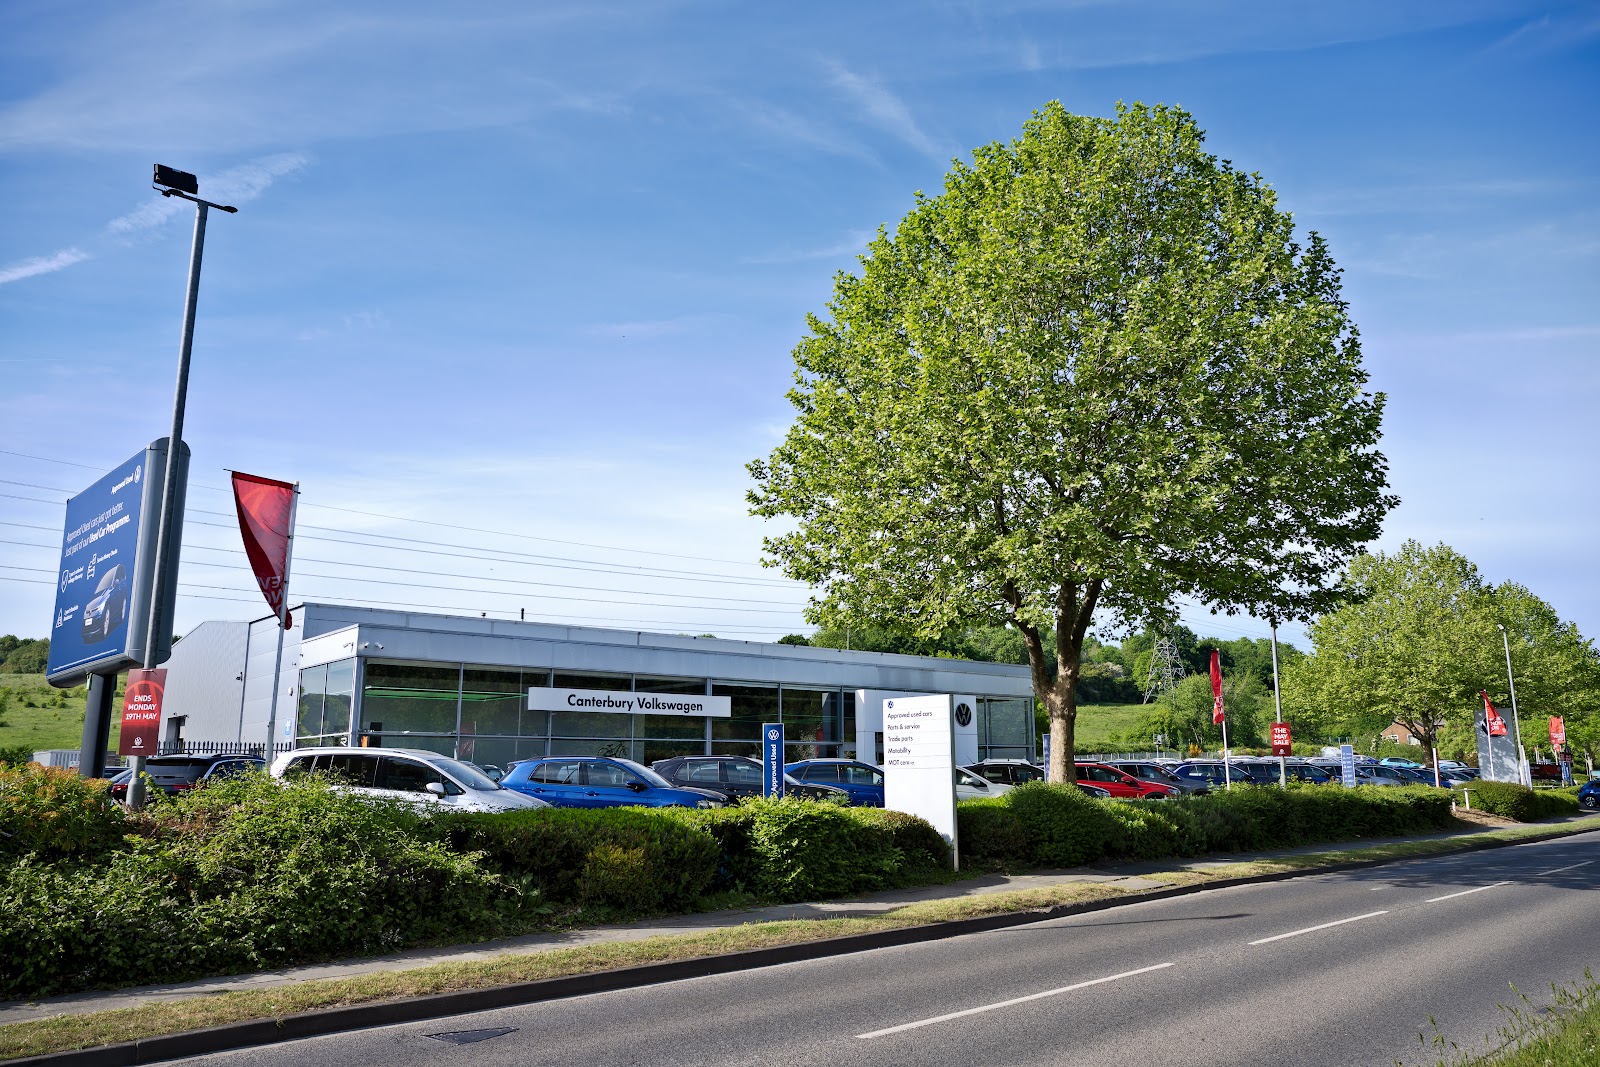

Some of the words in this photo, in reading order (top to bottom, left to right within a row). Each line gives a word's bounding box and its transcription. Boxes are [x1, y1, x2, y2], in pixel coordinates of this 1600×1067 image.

[568, 694, 634, 711] Canterbury
[637, 698, 703, 714] Volkswagen
[888, 710, 910, 720] Approved
